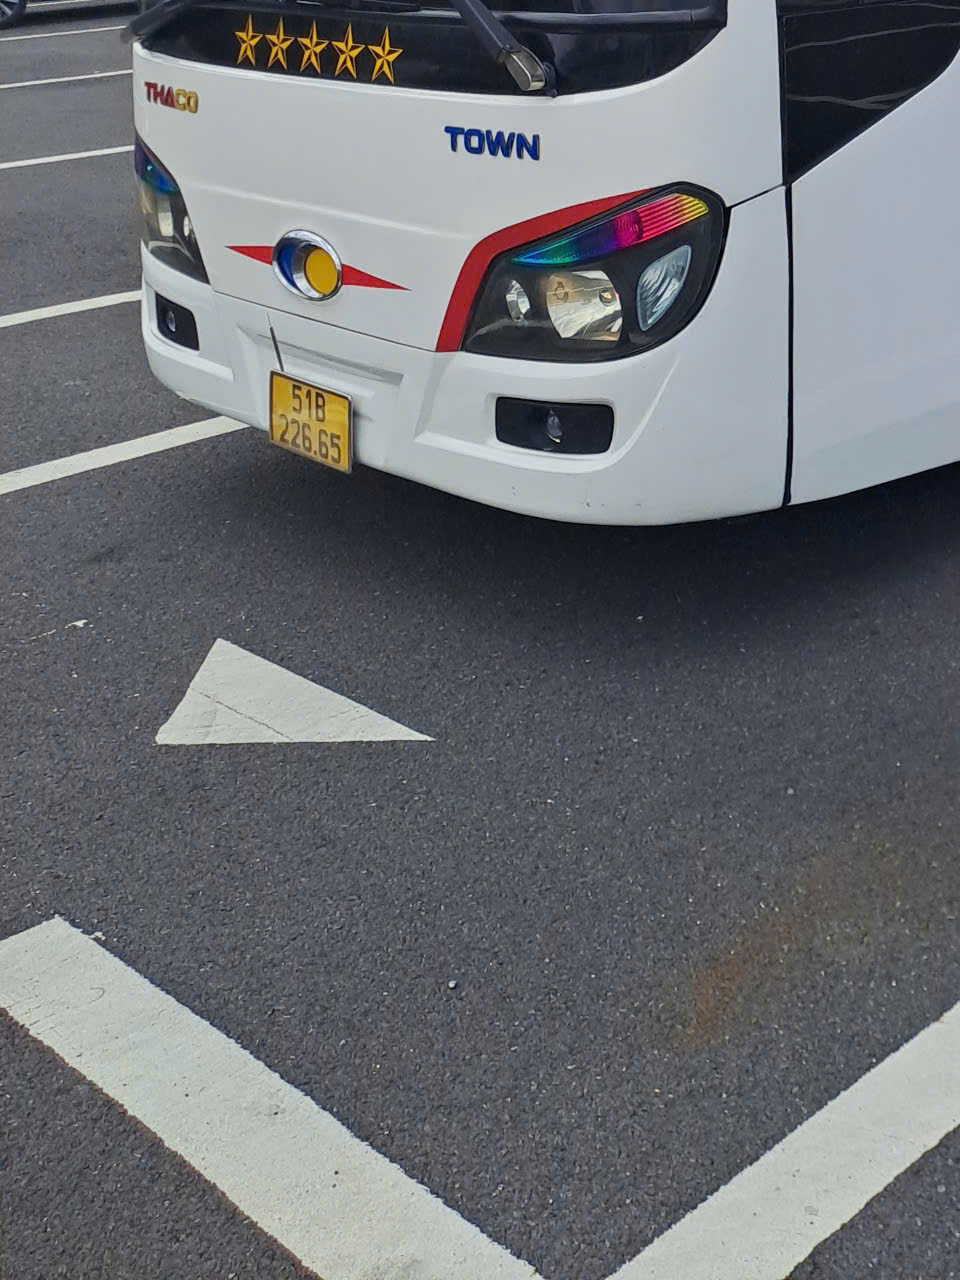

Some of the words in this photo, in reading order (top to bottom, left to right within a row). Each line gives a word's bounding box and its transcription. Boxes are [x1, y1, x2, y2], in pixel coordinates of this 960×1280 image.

[144, 81, 199, 114] THACO
[444, 125, 541, 161] TOWN
[291, 383, 326, 423] 51B
[279, 413, 342, 465] 226.65
